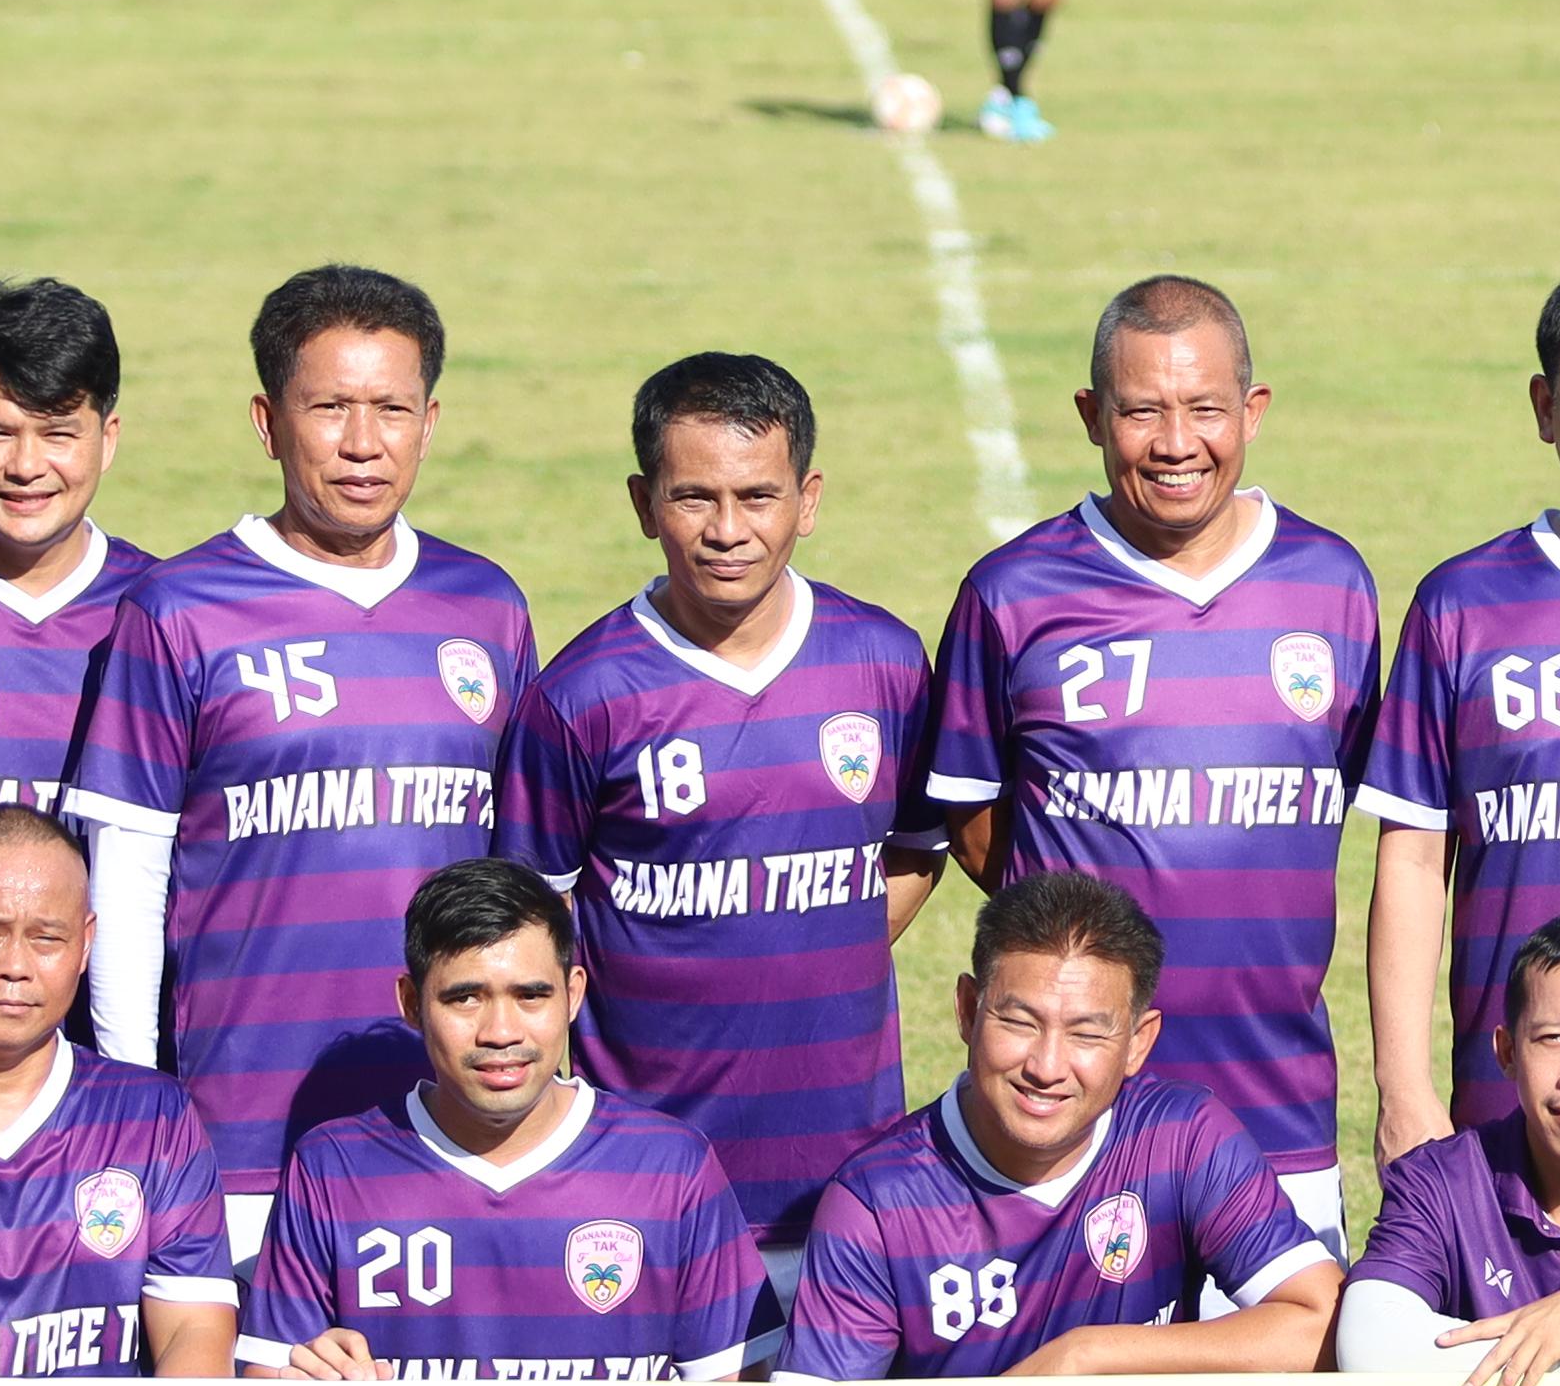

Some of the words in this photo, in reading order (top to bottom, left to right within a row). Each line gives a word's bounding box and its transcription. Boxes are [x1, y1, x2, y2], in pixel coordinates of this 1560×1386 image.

[237, 639, 339, 723] 45
[1057, 638, 1154, 723] 27
[223, 765, 375, 844] BANANA
[386, 763, 470, 830] TREE
[636, 737, 708, 820] 18
[1205, 766, 1305, 830] TREE
[762, 846, 858, 915] TREE
[355, 1224, 454, 1310] 20
[576, 1232, 610, 1244] BANANA
[613, 1231, 635, 1243] TREE
[593, 1241, 617, 1252] TAK
[928, 1256, 1018, 1342] 88
[7, 1307, 104, 1377] TREE
